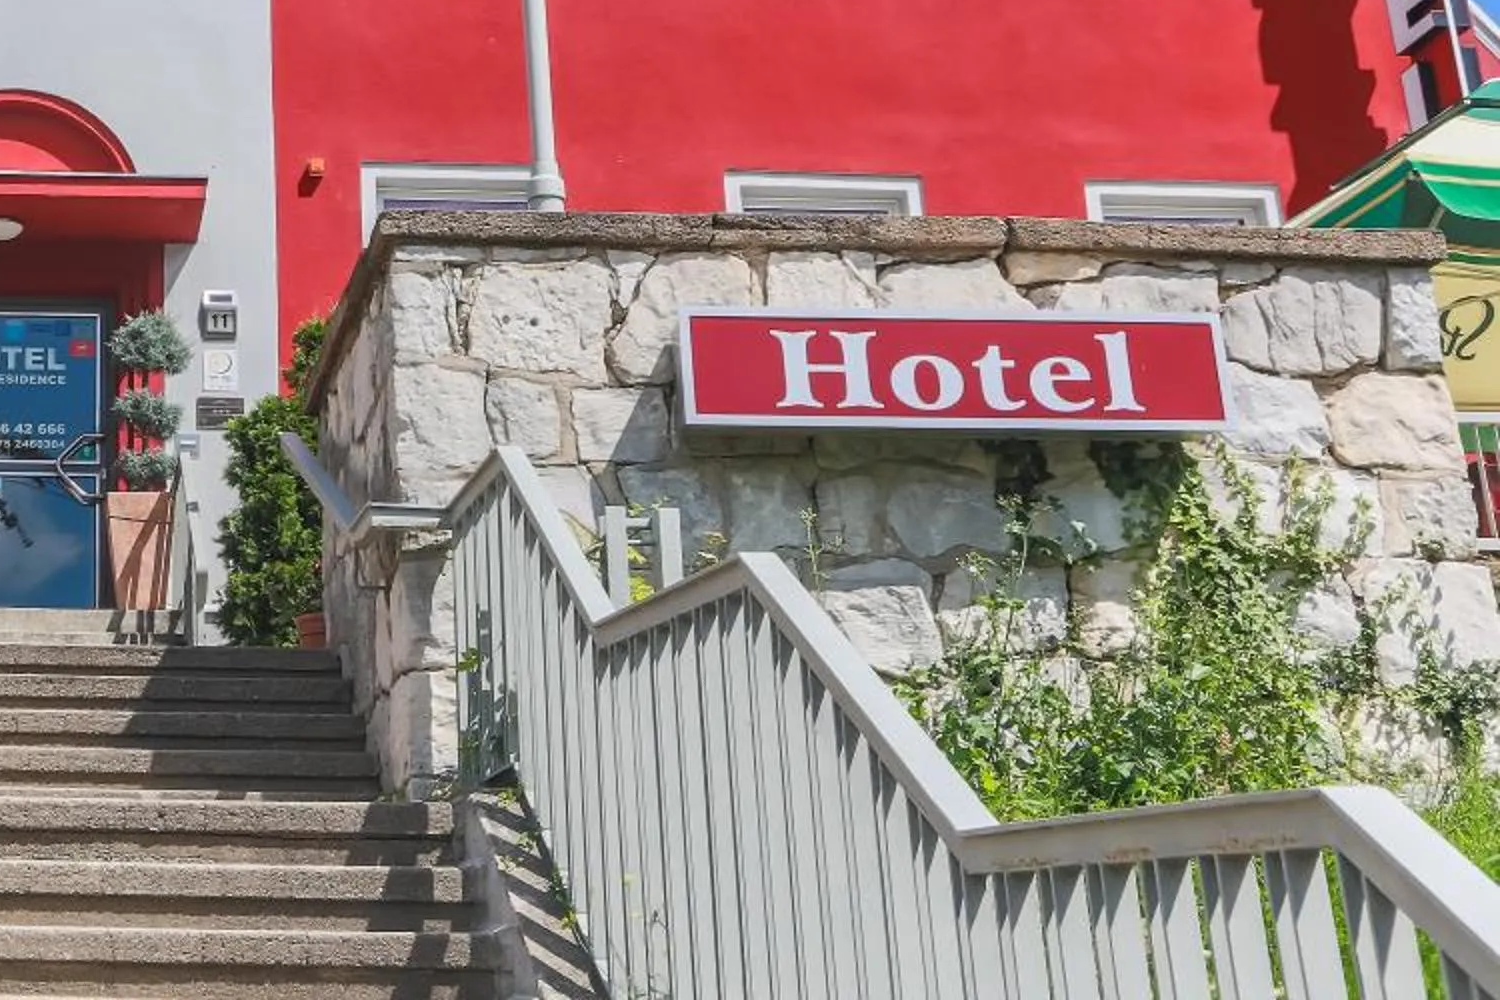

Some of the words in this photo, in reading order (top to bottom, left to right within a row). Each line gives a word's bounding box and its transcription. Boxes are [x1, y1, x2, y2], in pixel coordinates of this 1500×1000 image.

[211, 313, 228, 329] 11
[768, 328, 1147, 413] Hotel
[12, 423, 33, 435] 42
[37, 423, 66, 435] 666
